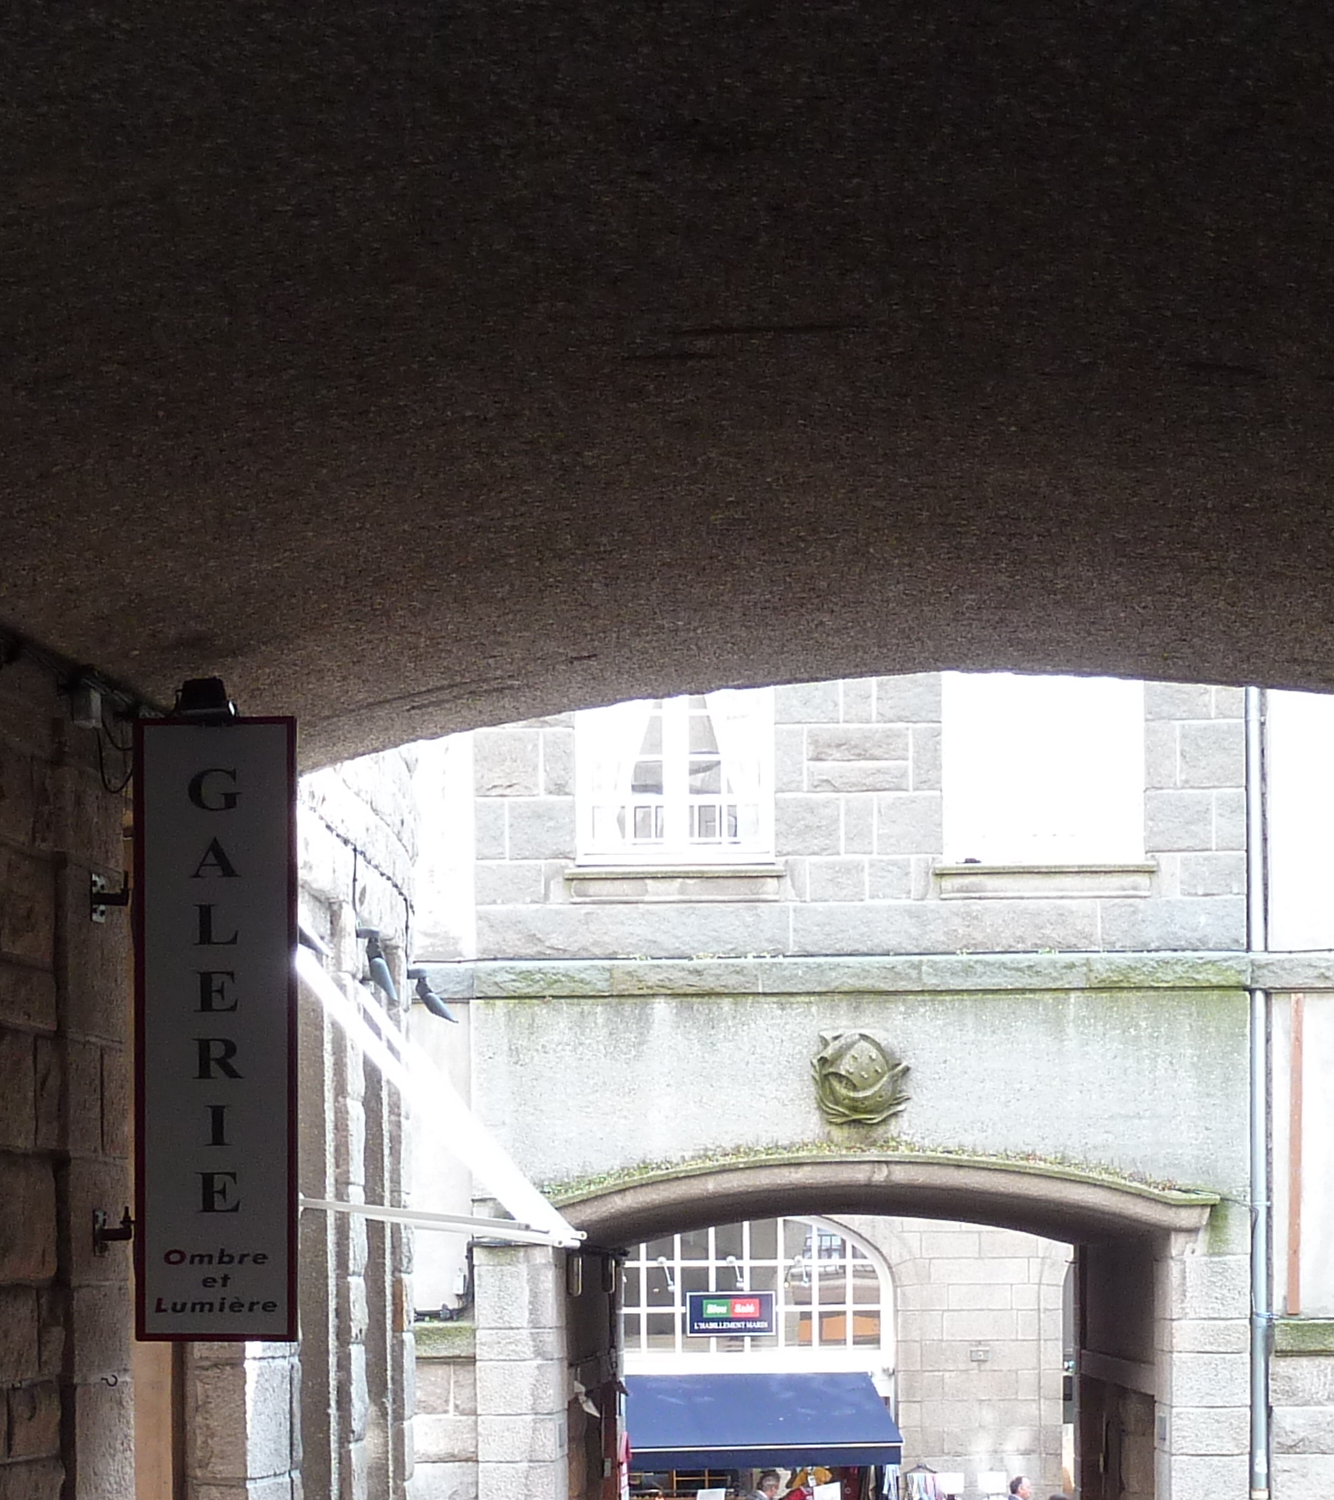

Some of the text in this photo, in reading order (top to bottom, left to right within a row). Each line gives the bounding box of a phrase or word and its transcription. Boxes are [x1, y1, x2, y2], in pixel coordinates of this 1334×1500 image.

[186, 767, 244, 1214] GALERIE
[163, 1247, 269, 1266] Ombre
[201, 1273, 231, 1288] et
[154, 1296, 278, 1314] Lumière
